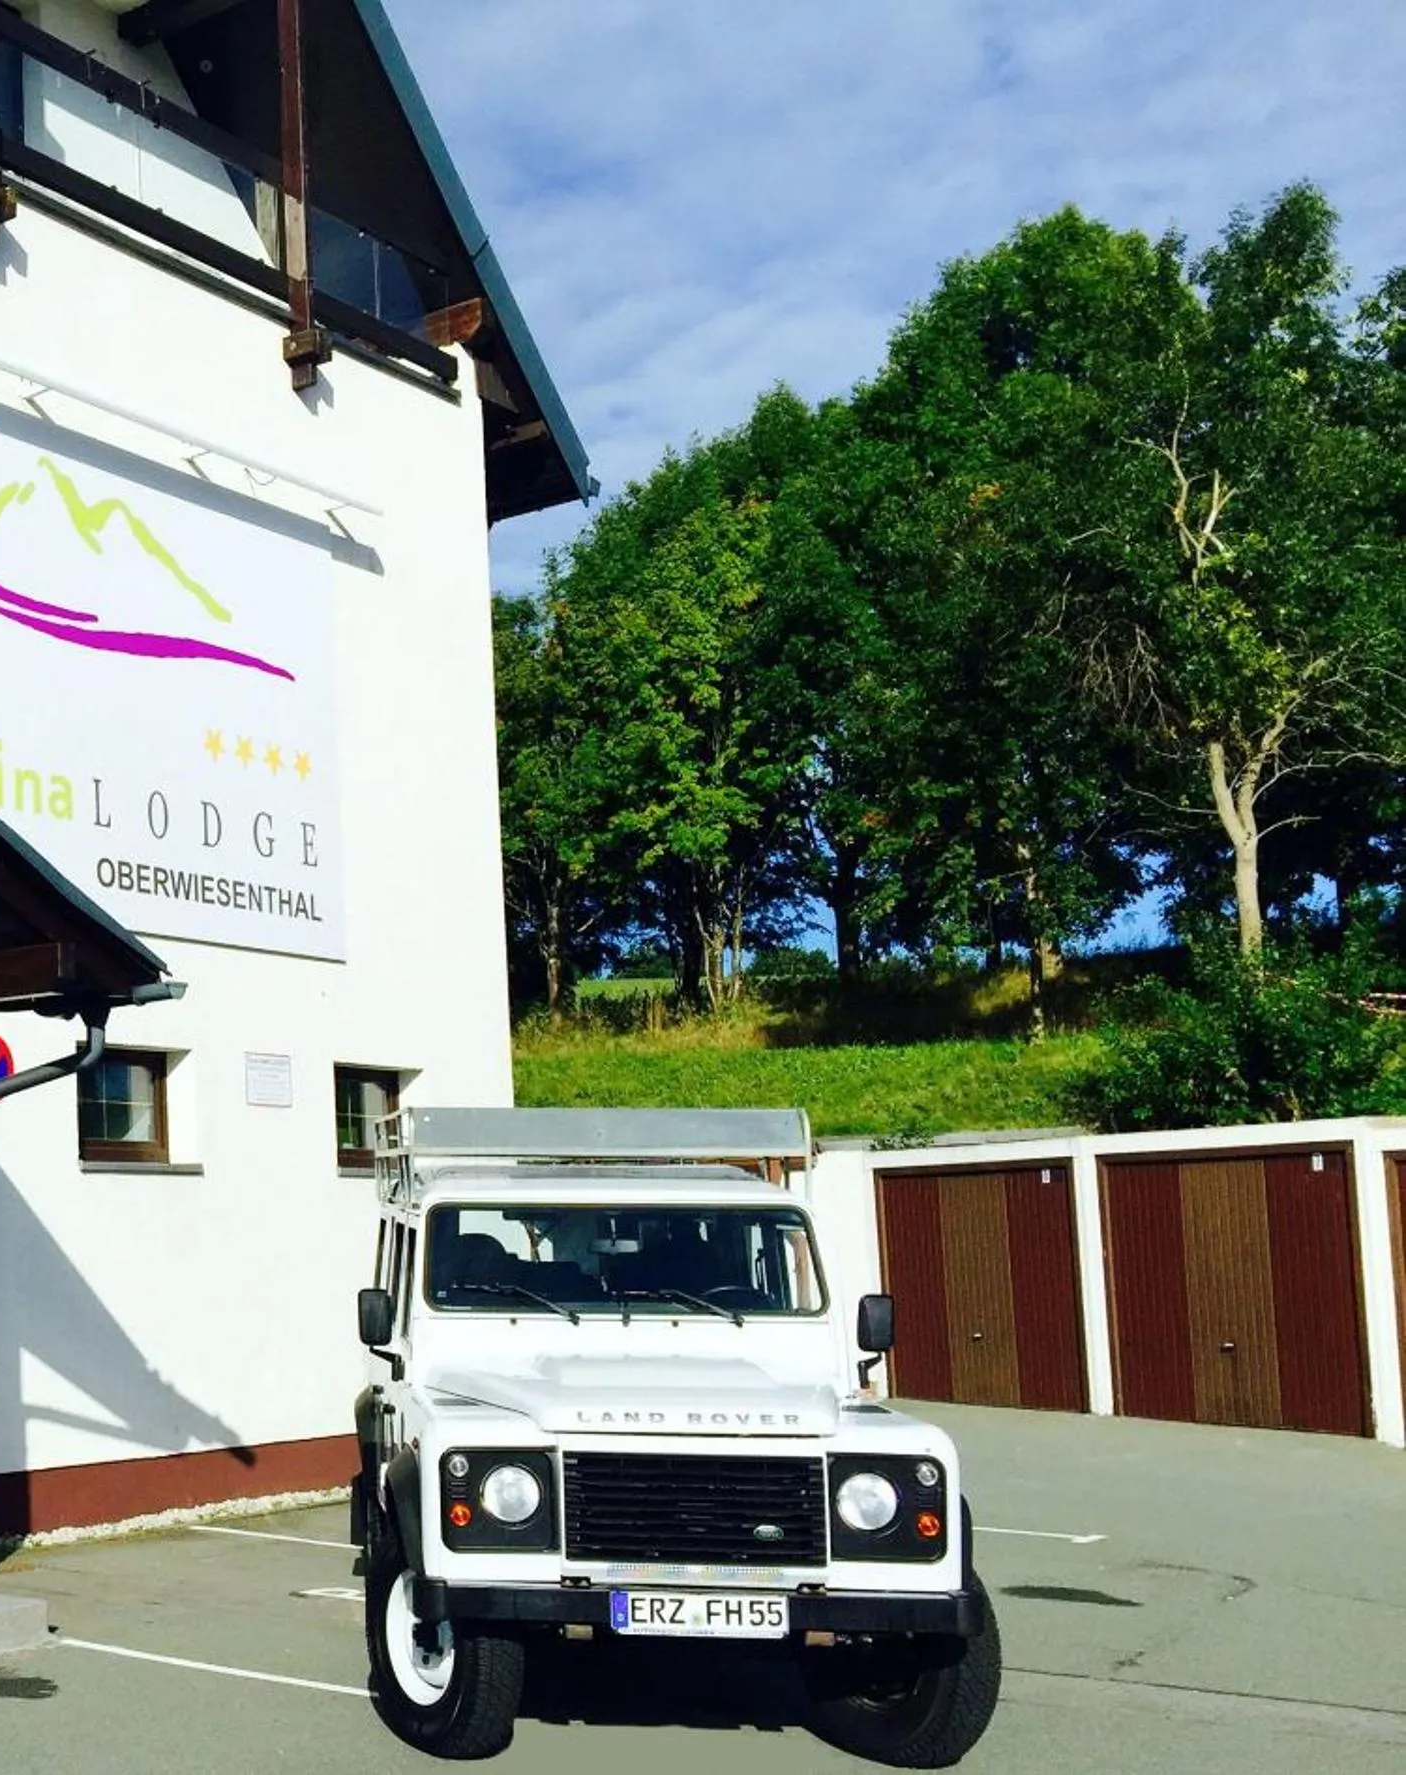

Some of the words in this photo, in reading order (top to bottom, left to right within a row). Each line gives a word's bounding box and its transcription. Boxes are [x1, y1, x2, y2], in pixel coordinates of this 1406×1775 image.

[93, 778, 319, 867] LODGE
[96, 857, 322, 922] OBERWIESENTHAL
[577, 1411, 665, 1424] LAND
[687, 1412, 801, 1426] ROVER
[631, 1598, 686, 1625] ERZ
